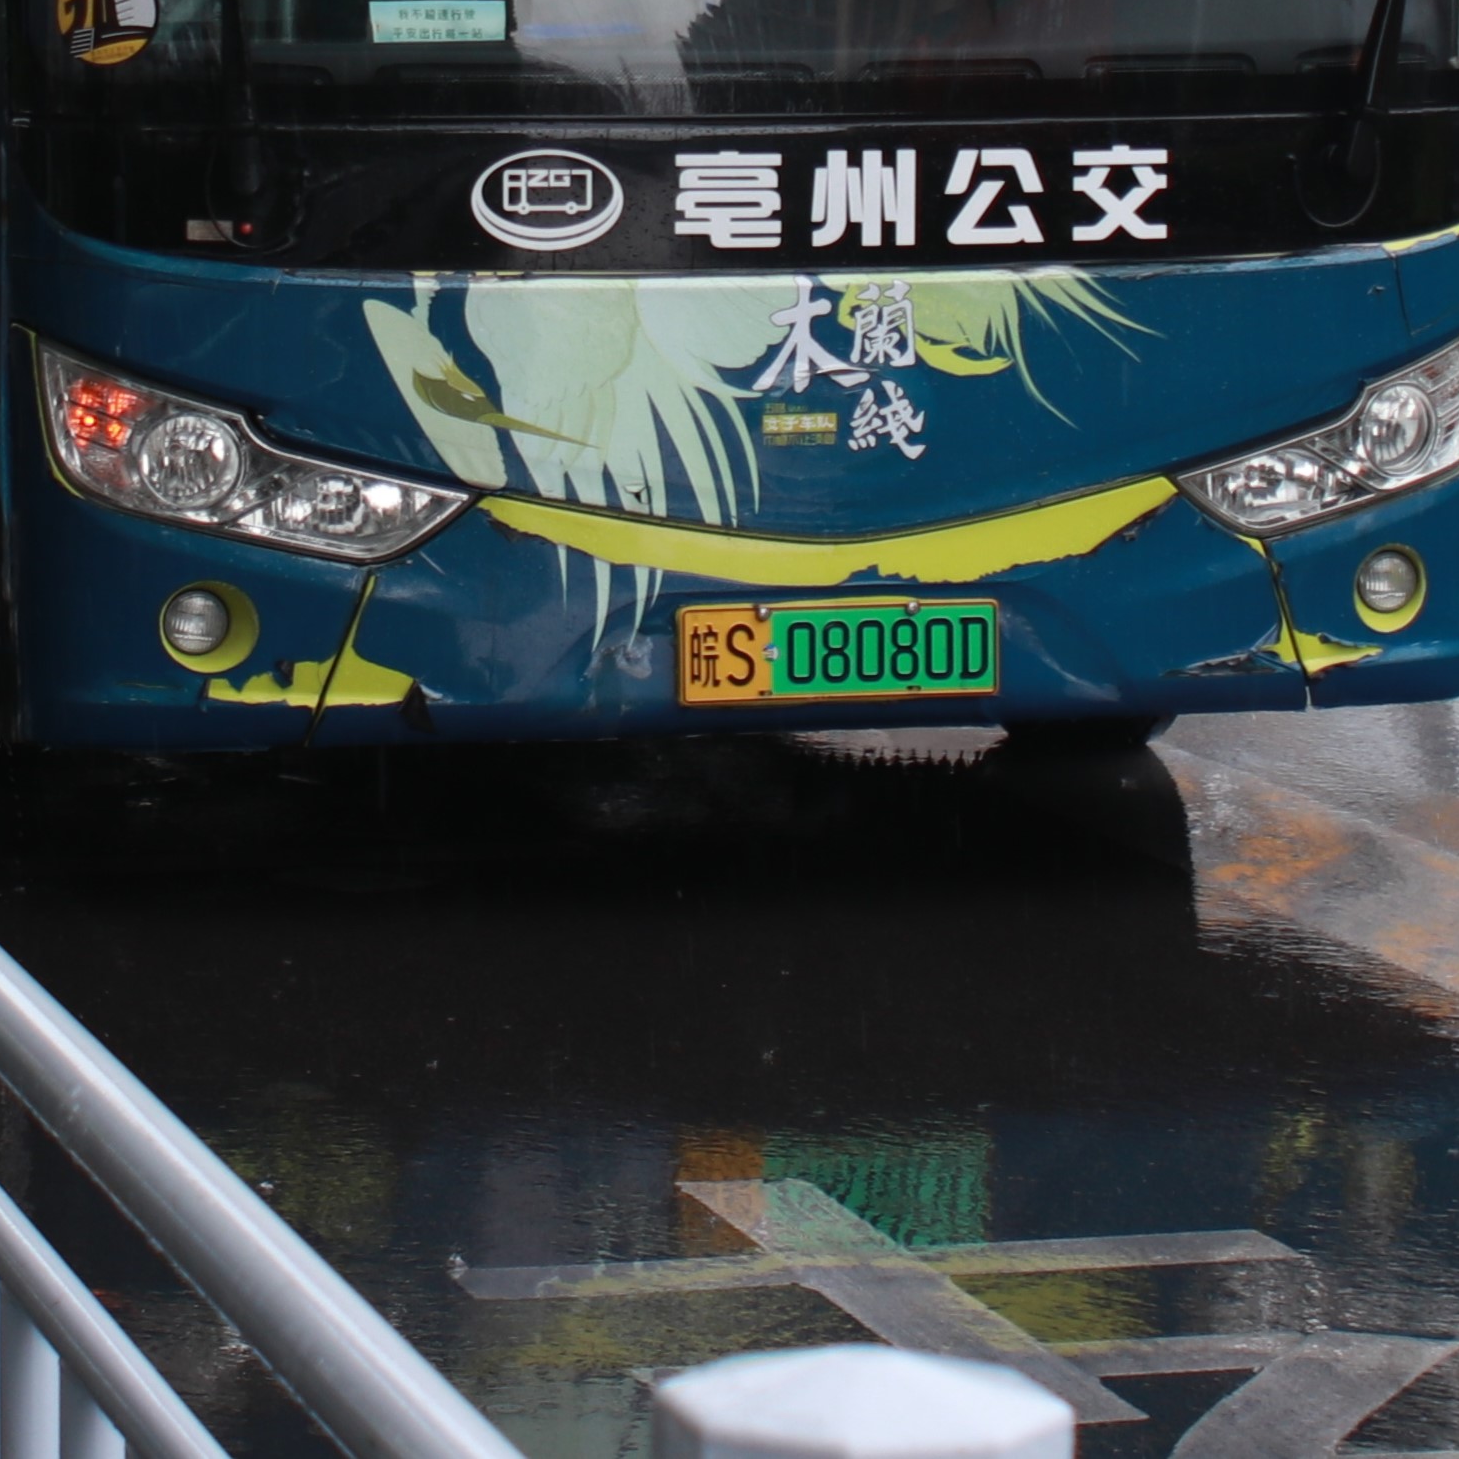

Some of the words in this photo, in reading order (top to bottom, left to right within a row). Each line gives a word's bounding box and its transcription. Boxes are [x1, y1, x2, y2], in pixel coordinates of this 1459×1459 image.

[674, 143, 1169, 249] 亳州公交
[764, 415, 835, 431] 女子车队
